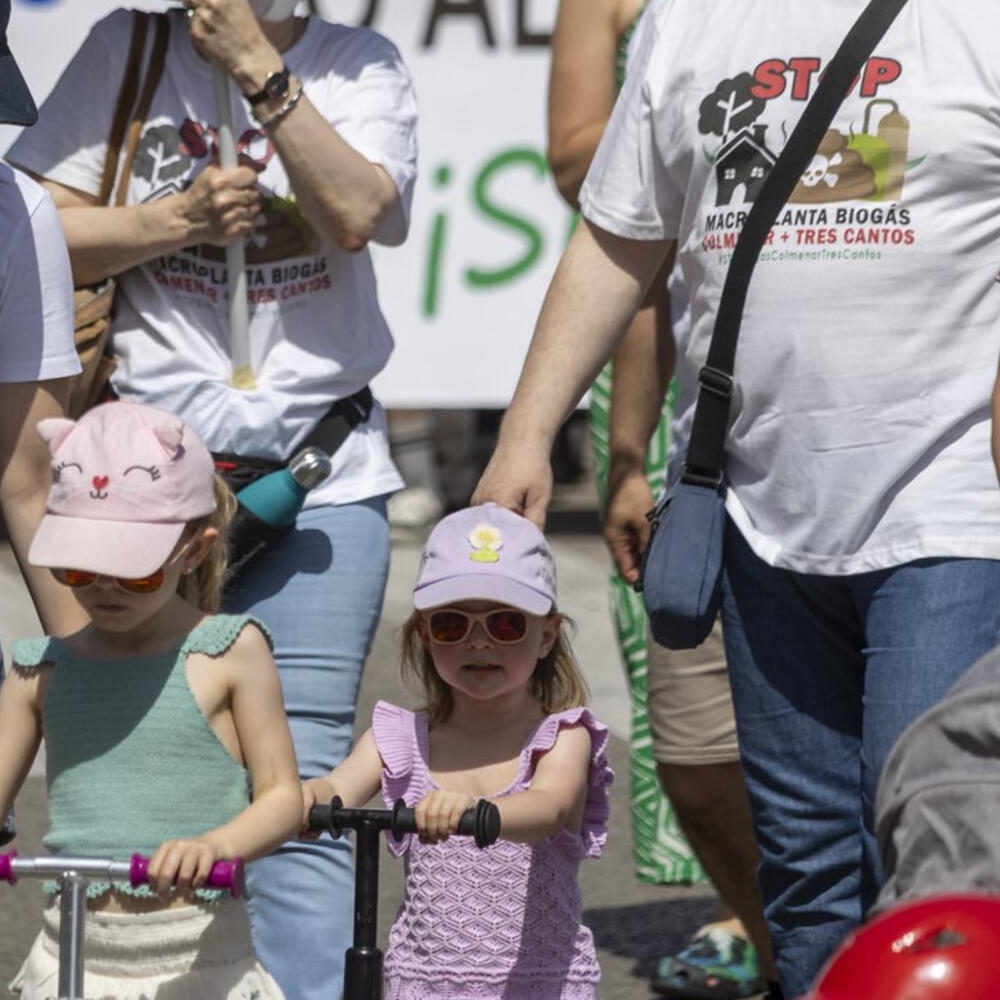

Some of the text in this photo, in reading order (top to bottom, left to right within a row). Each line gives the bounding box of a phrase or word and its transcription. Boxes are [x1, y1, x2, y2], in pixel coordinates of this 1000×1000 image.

[750, 55, 902, 101] STP
[705, 203, 912, 232] MACRANTA BIOGÁS
[701, 230, 776, 252] COLMR
[796, 229, 837, 246] TRES
[843, 228, 915, 246] CANTOS
